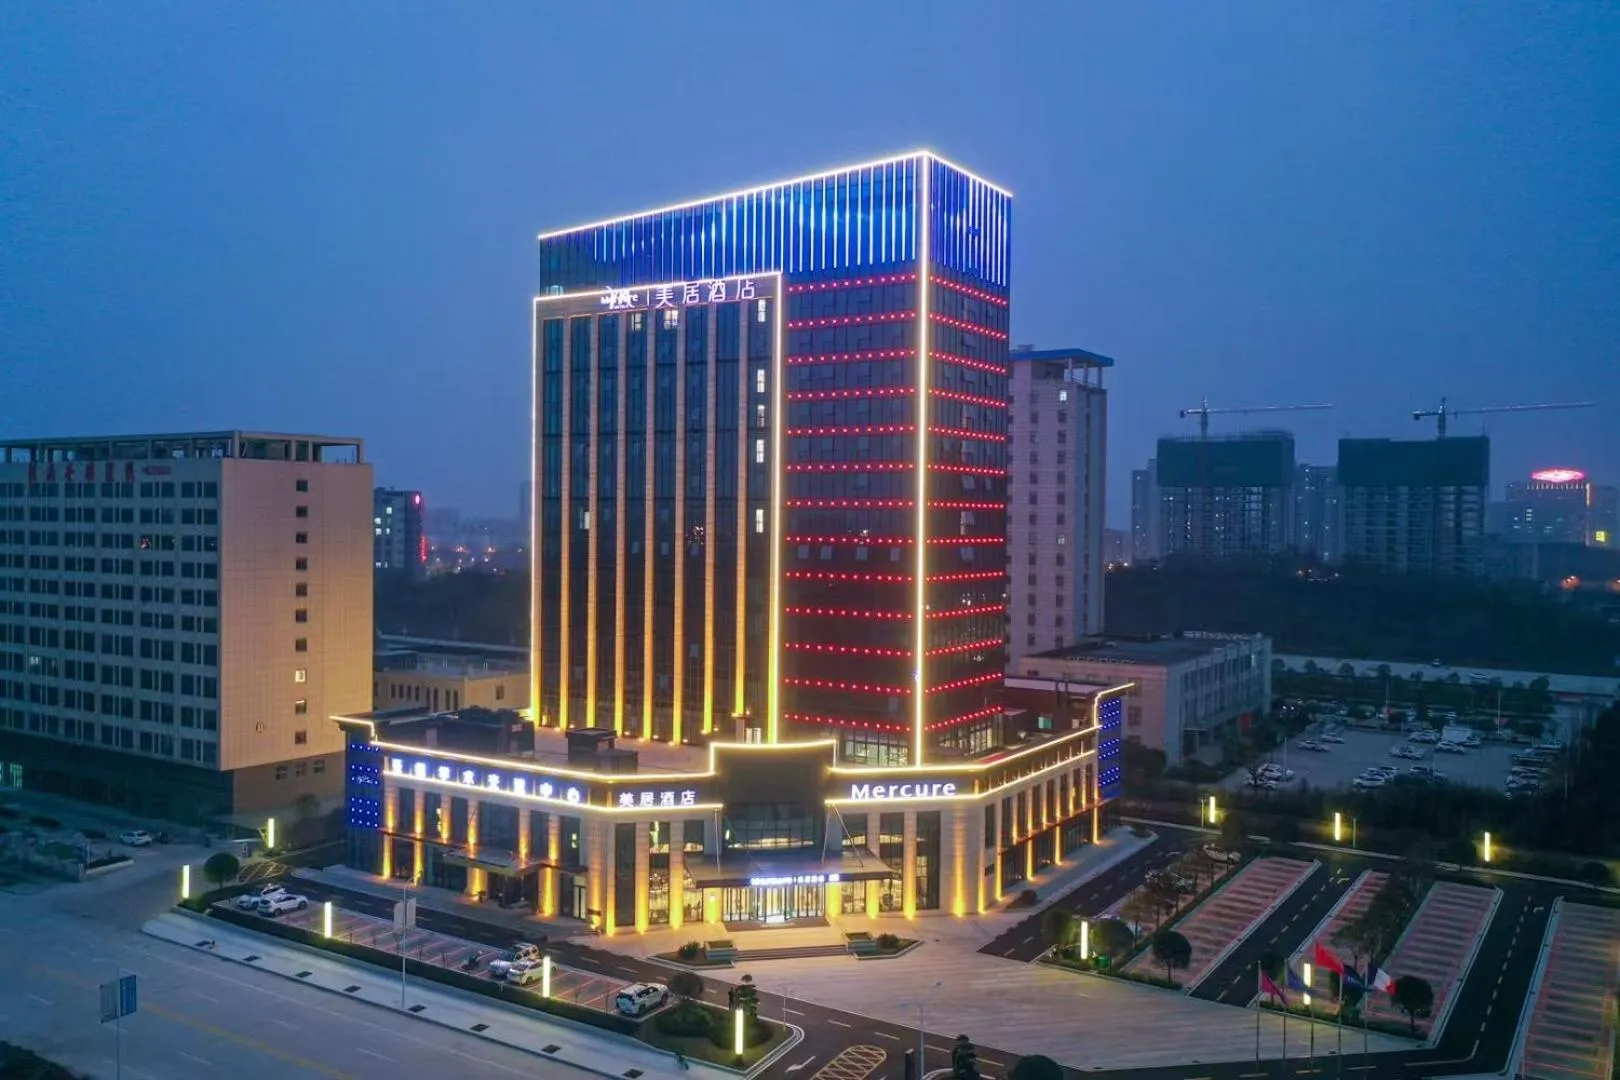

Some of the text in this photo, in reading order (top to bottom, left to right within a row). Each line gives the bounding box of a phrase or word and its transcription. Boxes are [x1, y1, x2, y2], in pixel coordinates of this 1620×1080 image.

[655, 279, 755, 308] 美居酒店
[619, 790, 697, 807] 美居酒店
[850, 782, 956, 800] Mercure
